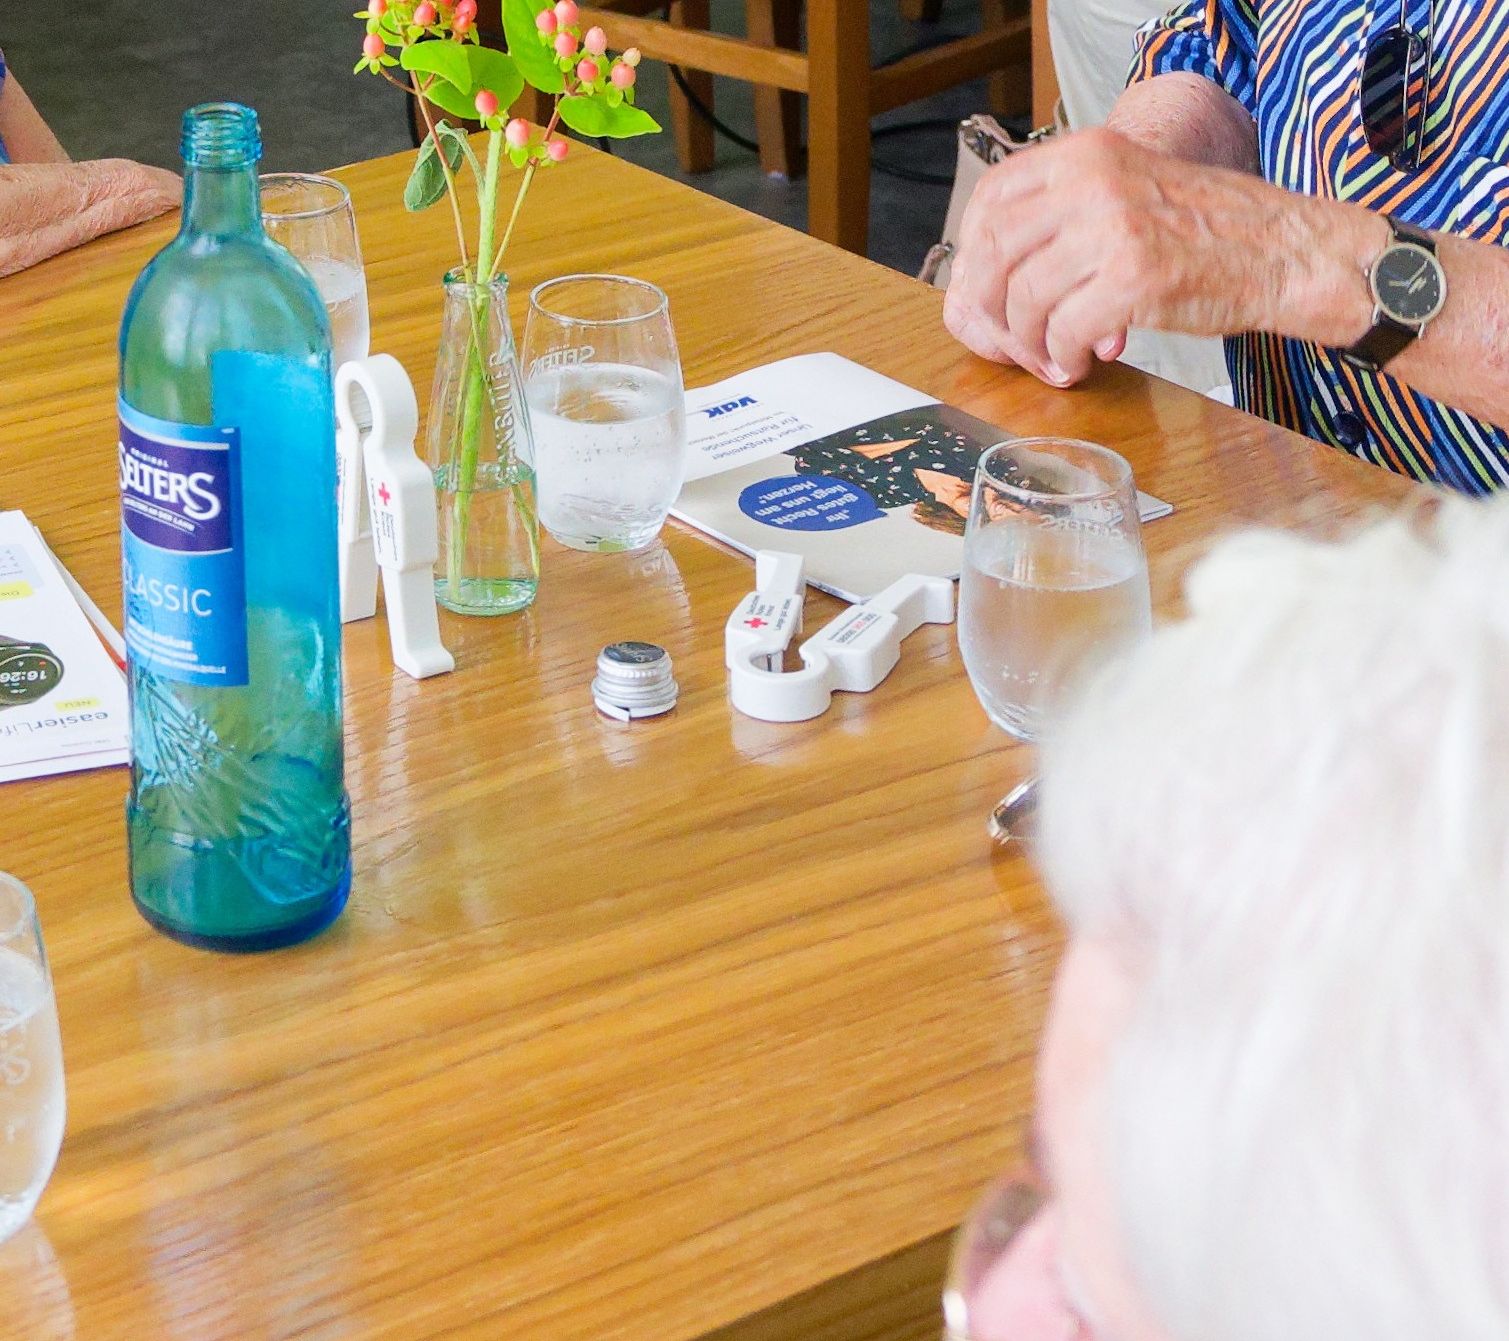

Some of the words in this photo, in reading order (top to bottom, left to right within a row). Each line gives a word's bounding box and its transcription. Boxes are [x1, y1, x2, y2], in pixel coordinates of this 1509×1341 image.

[118, 441, 222, 521] SELTERS
[810, 484, 848, 500] liegt
[754, 505, 781, 516] am
[781, 496, 811, 509] uns
[770, 508, 819, 525] Recht
